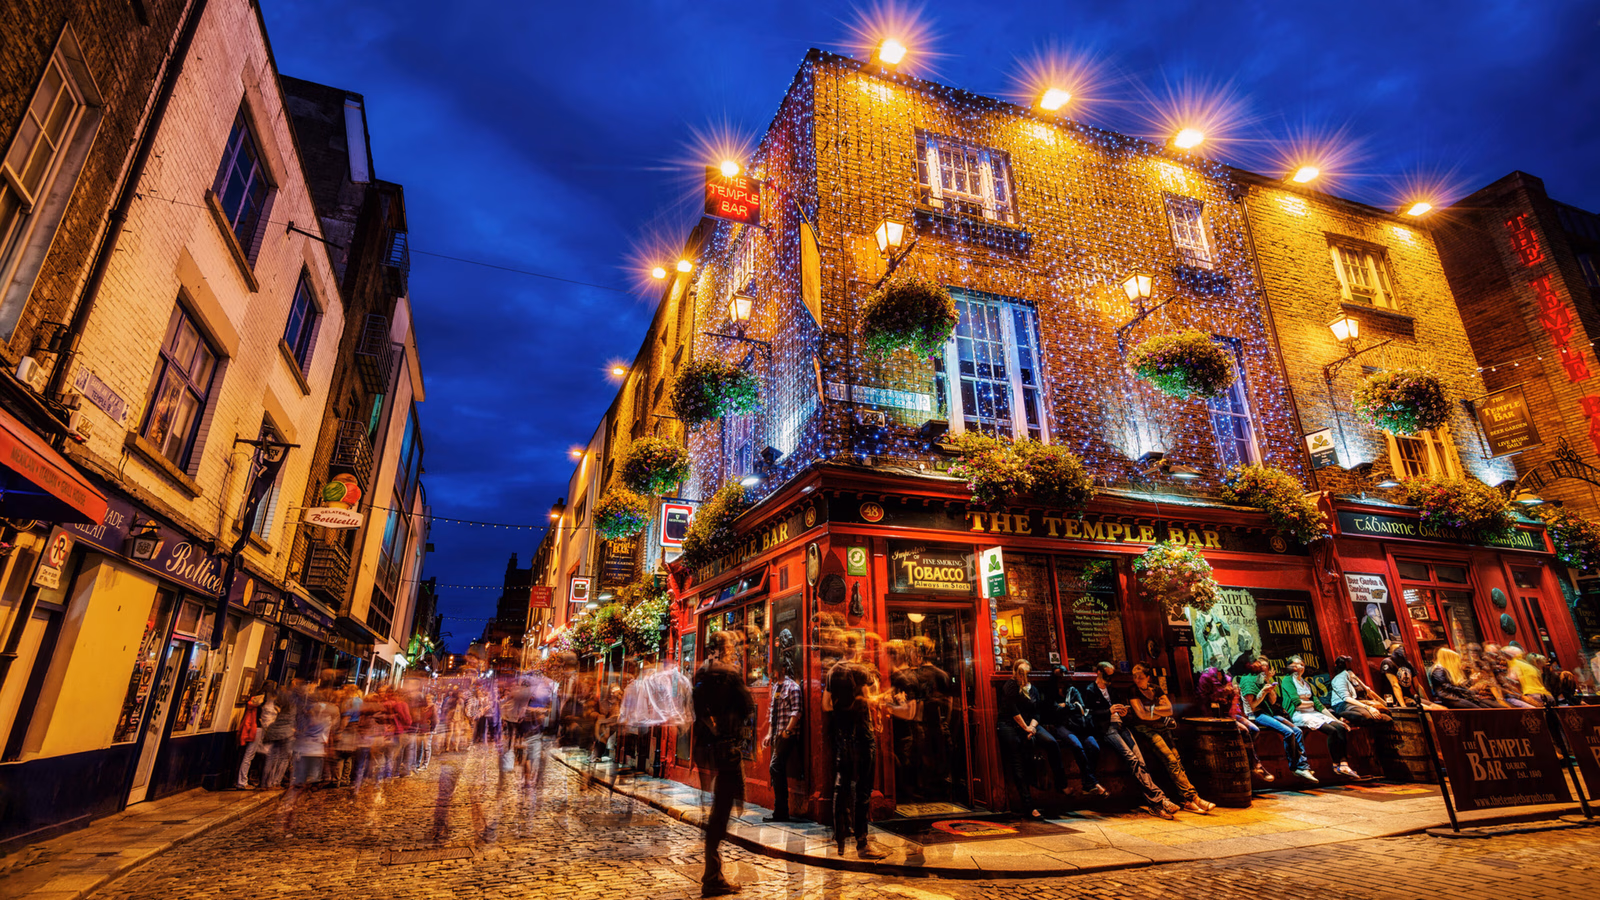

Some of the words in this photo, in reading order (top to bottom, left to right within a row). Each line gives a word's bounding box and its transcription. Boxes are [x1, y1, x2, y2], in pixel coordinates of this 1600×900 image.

[709, 184, 759, 205] TEMPLE
[722, 201, 747, 216] BAR
[1504, 212, 1545, 267] THE
[1528, 273, 1591, 383] TEMPLE
[1491, 395, 1505, 403] THE
[1482, 401, 1521, 417] TEMPLE
[1493, 411, 1515, 422] BAR
[1489, 428, 1505, 436] BEER
[1505, 421, 1528, 432] GARDEN
[1497, 440, 1511, 448] LIVE
[1512, 435, 1529, 444] MUSIC
[1506, 442, 1523, 450] DAILY
[864, 506, 878, 516] 48
[311, 513, 359, 526] Botticelli
[966, 510, 1032, 536] THE
[1042, 515, 1157, 543] TEMPLE
[1167, 527, 1222, 549] BAR
[607, 540, 636, 549] TEMPLE
[612, 546, 629, 554] BAR
[698, 562, 715, 583] THE
[719, 538, 758, 574] TEMPLE
[762, 522, 789, 551] BAR
[901, 561, 964, 585] TOBACCO
[1346, 576, 1359, 584] Beer
[1359, 577, 1379, 586] Garden
[1349, 584, 1371, 594] Smoking
[1072, 596, 1095, 608] TEMPLE
[1096, 598, 1109, 610] BAR
[1356, 593, 1368, 601] Area
[1221, 605, 1245, 618] BAR
[1286, 605, 1307, 619] THE
[1268, 619, 1311, 635] EMPEROR
[1301, 638, 1313, 651] OF
[1462, 741, 1477, 750] THE
[1473, 730, 1535, 759] TEMPLE
[1466, 752, 1508, 782] BAR
[1505, 762, 1528, 770] DUBLIN
[1530, 770, 1542, 778] 1840
[1473, 792, 1557, 808] www.thetemplebarpub.com
